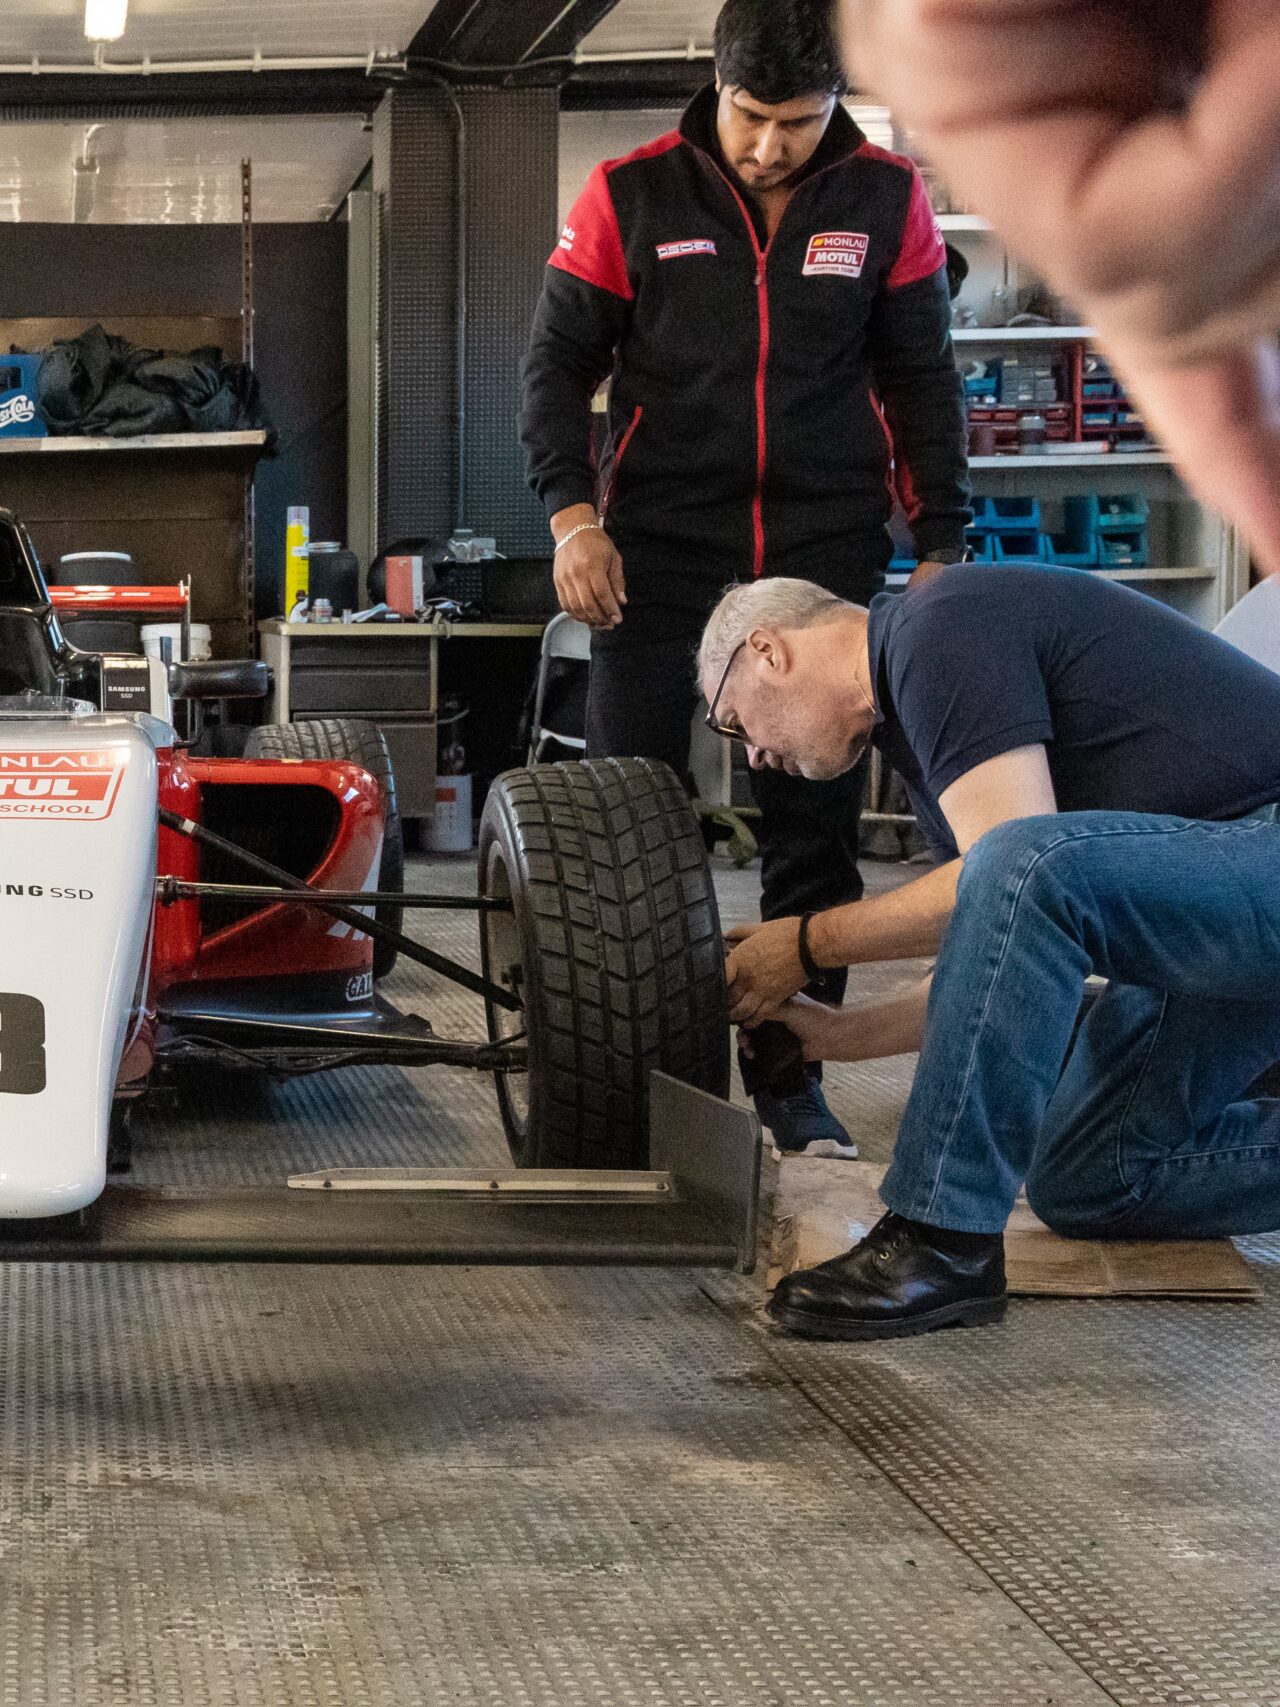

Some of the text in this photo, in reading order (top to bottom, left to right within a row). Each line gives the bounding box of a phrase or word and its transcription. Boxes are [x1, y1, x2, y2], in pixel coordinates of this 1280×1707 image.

[824, 237, 865, 249] MONLAU
[813, 252, 858, 265] MOTUL
[49, 887, 94, 901] SSD
